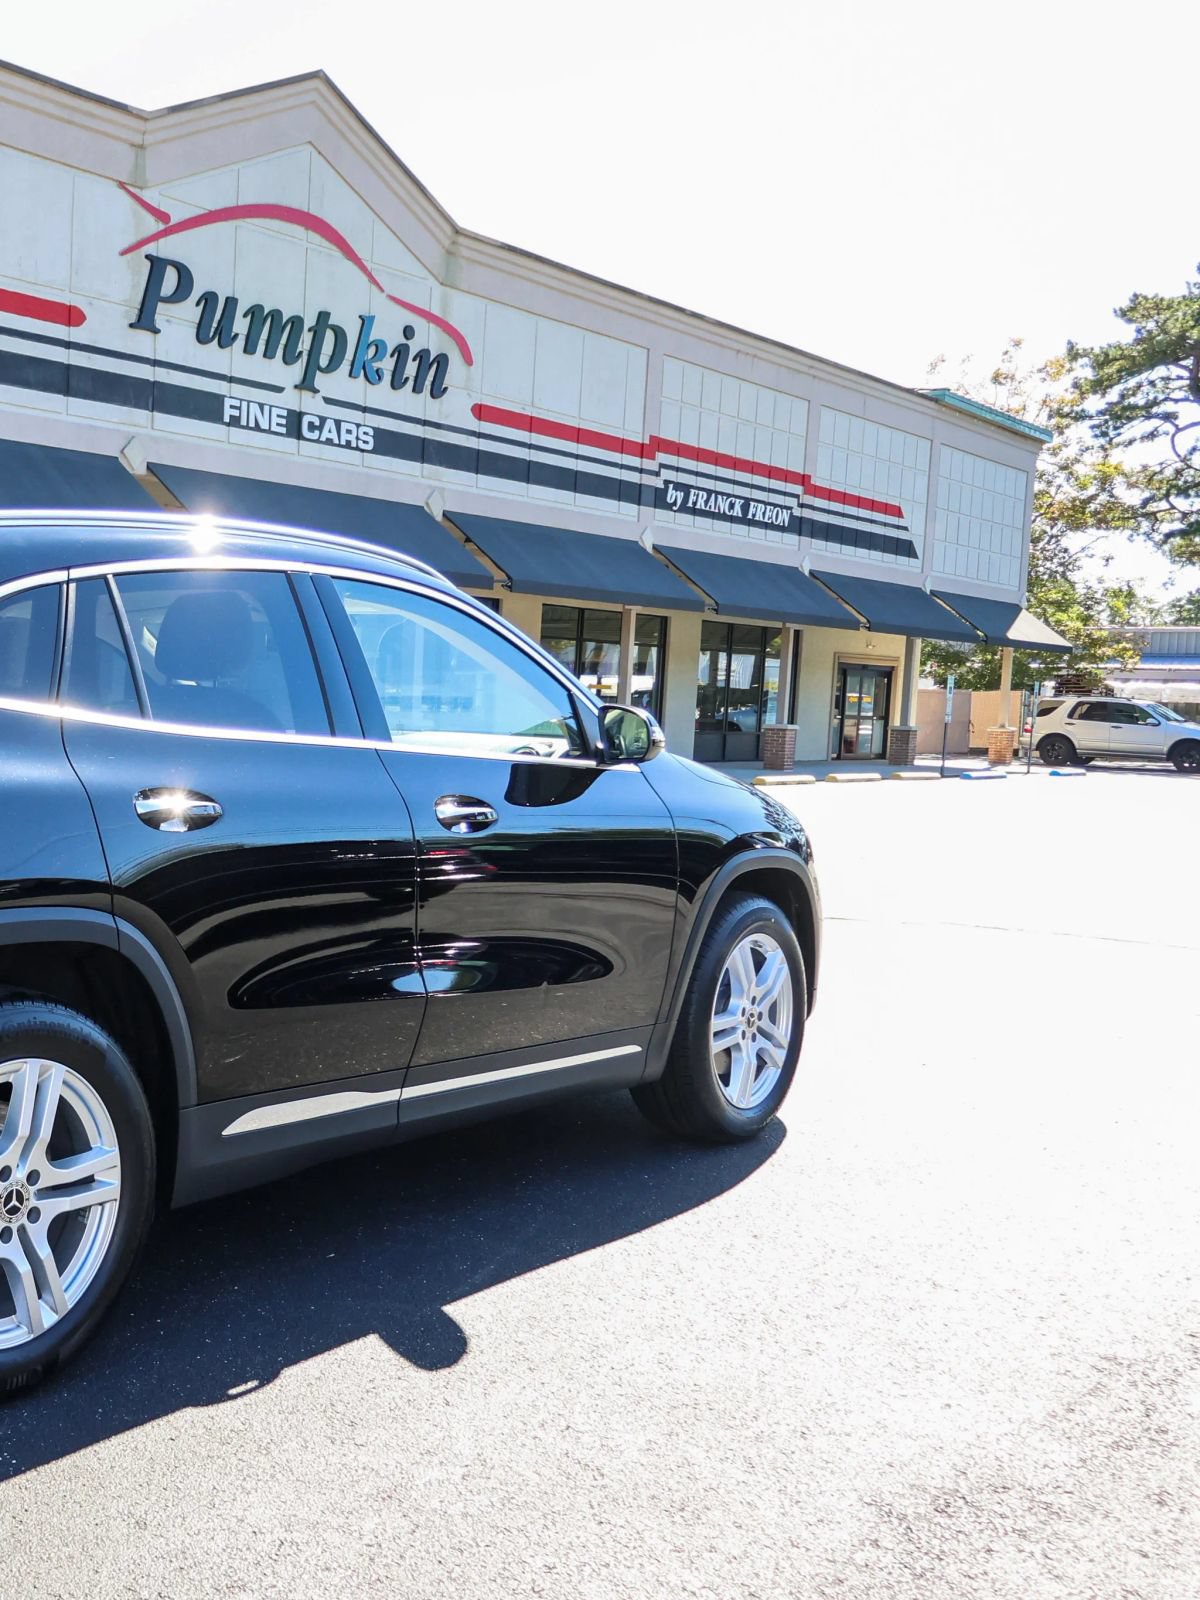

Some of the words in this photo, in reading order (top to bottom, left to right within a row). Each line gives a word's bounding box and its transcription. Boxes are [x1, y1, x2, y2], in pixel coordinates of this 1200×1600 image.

[128, 253, 450, 400] Pumpkin
[223, 397, 288, 435] FINE
[301, 413, 375, 451] CARS
[666, 483, 684, 511] by
[686, 488, 745, 518] FRANCK
[747, 501, 792, 528] FREON
